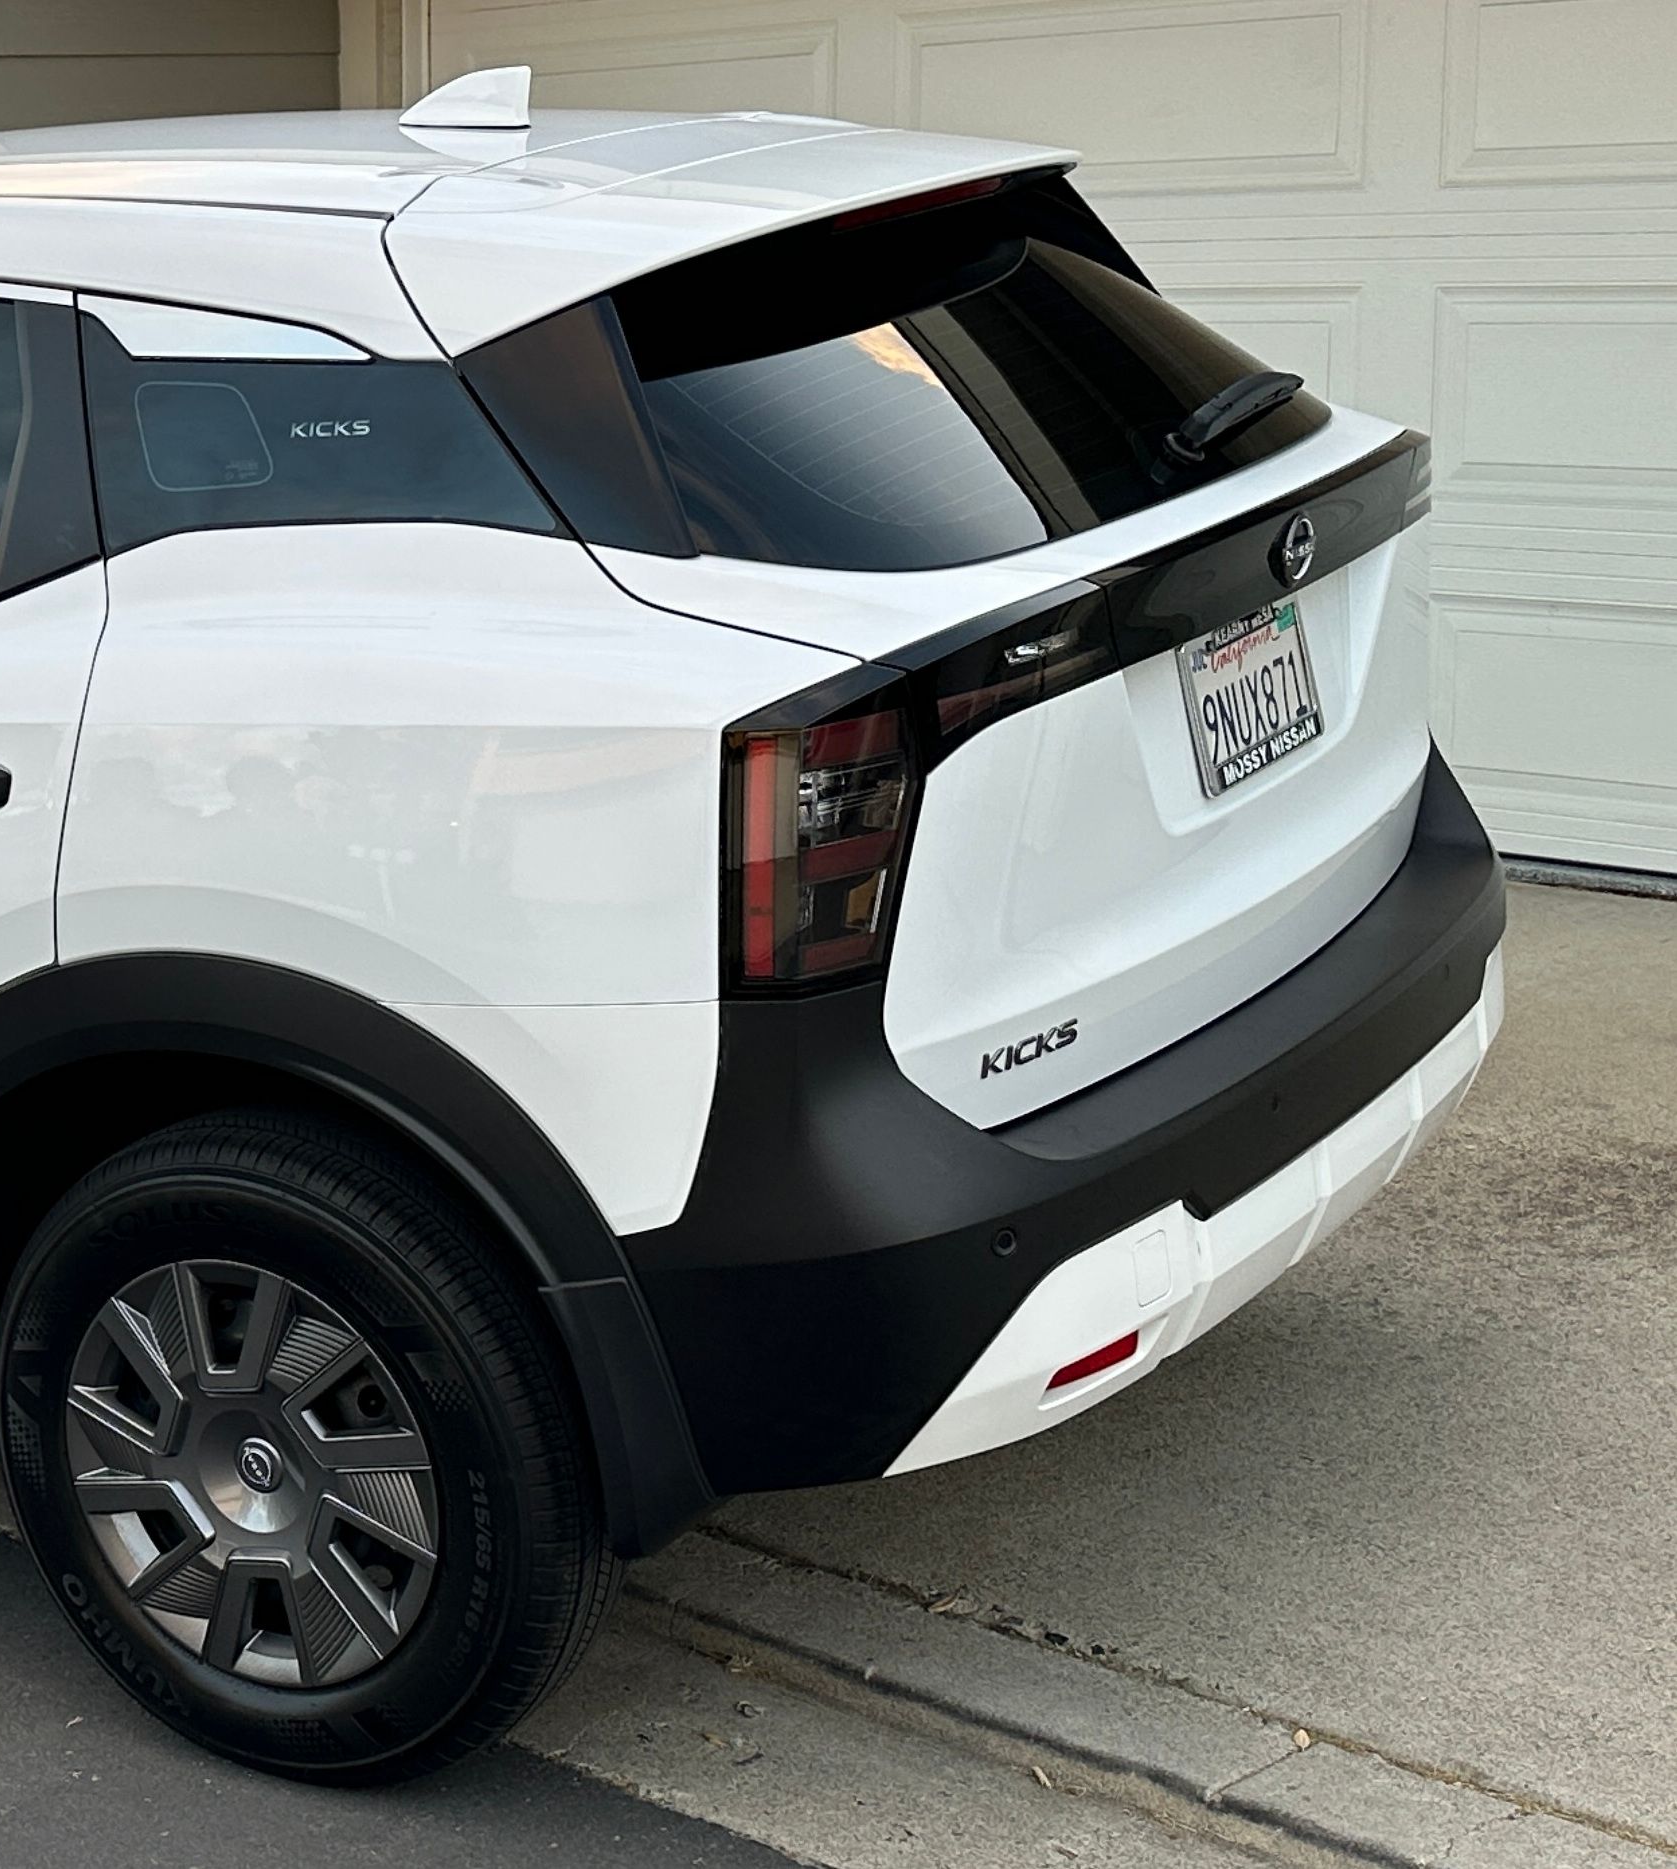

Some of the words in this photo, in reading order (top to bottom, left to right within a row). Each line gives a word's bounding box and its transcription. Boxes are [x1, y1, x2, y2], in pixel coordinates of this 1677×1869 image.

[289, 419, 371, 438] KICKS
[1210, 625, 1280, 674] California
[1202, 650, 1309, 765] 9NUX871
[1222, 745, 1270, 786] MOSSY
[1268, 718, 1317, 760] NISSAN
[980, 1017, 1078, 1079] KICKS
[468, 1468, 494, 1571] 215/65
[464, 1574, 489, 1632] R16
[62, 1572, 190, 1718] KUMHO
